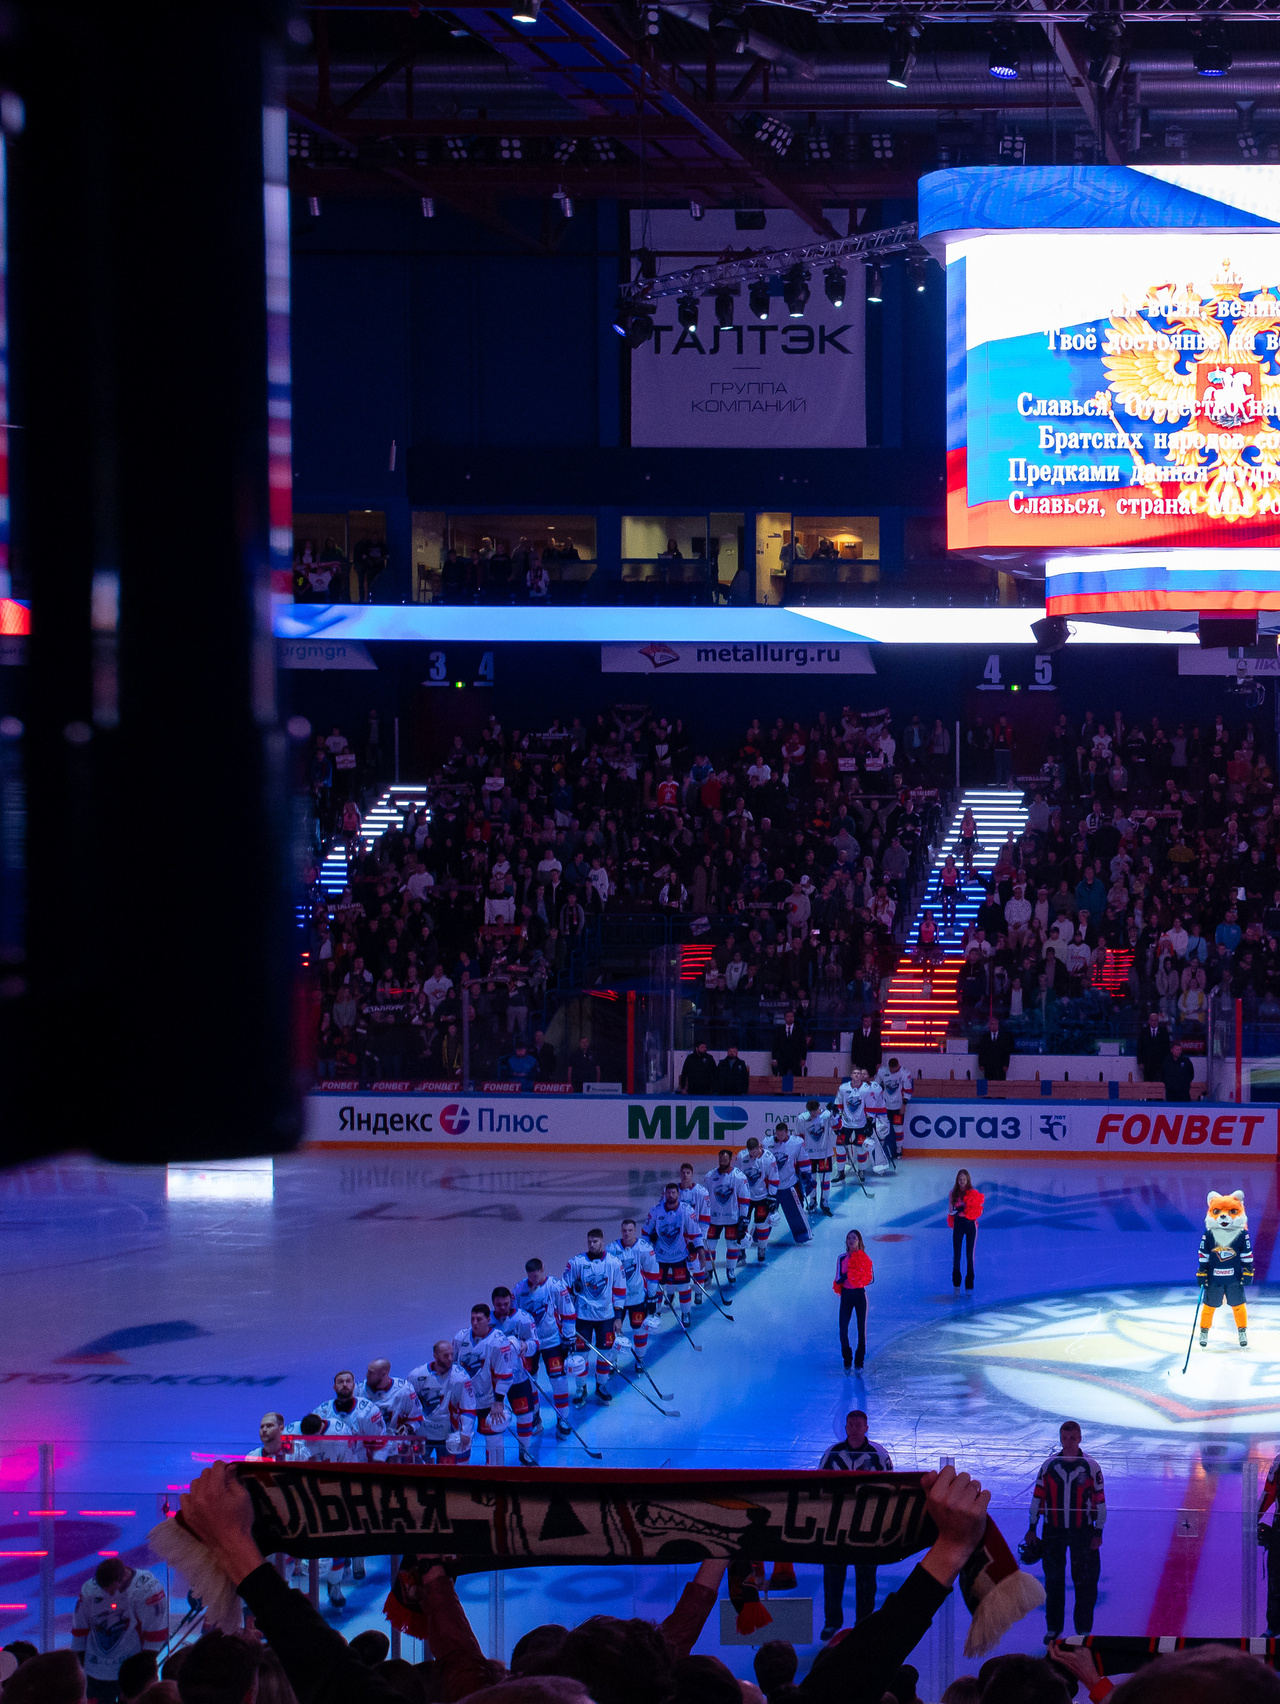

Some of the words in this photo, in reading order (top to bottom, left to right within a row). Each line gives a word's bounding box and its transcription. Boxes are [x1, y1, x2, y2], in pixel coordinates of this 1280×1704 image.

[650, 324, 855, 355] ТАЛТЭК
[1043, 327, 1097, 351] Твоё
[1108, 333, 1220, 355] достоянье
[1229, 333, 1256, 351] на
[710, 382, 788, 395] ГРУППА
[691, 397, 807, 412] КОМПАНИЙ
[1017, 392, 1115, 419] Славься,
[1124, 392, 1238, 418] Отечество
[1038, 425, 1143, 454] Братских
[1153, 431, 1246, 454] народов
[1008, 457, 1120, 487] Предками
[1129, 464, 1209, 486] данная
[1008, 490, 1106, 518] Славься,
[1115, 491, 1198, 520] страна!
[1207, 491, 1250, 516] Мы
[428, 651, 447, 681] 3
[477, 651, 495, 681] 4
[696, 644, 840, 666] metallurg.ru
[983, 654, 1001, 684] 4
[1033, 654, 1054, 685] 5
[321, 1081, 360, 1091] FONBET
[372, 1081, 411, 1091] FONBET
[422, 1081, 460, 1091] FONBET
[483, 1082, 522, 1092] FONBET
[533, 1083, 572, 1093] FONBET
[338, 1106, 432, 1134] Яндекс
[477, 1108, 549, 1133] Плюс
[627, 1105, 749, 1141] МИР
[909, 1114, 1021, 1140] согаз
[1096, 1113, 1265, 1146] FONBET
